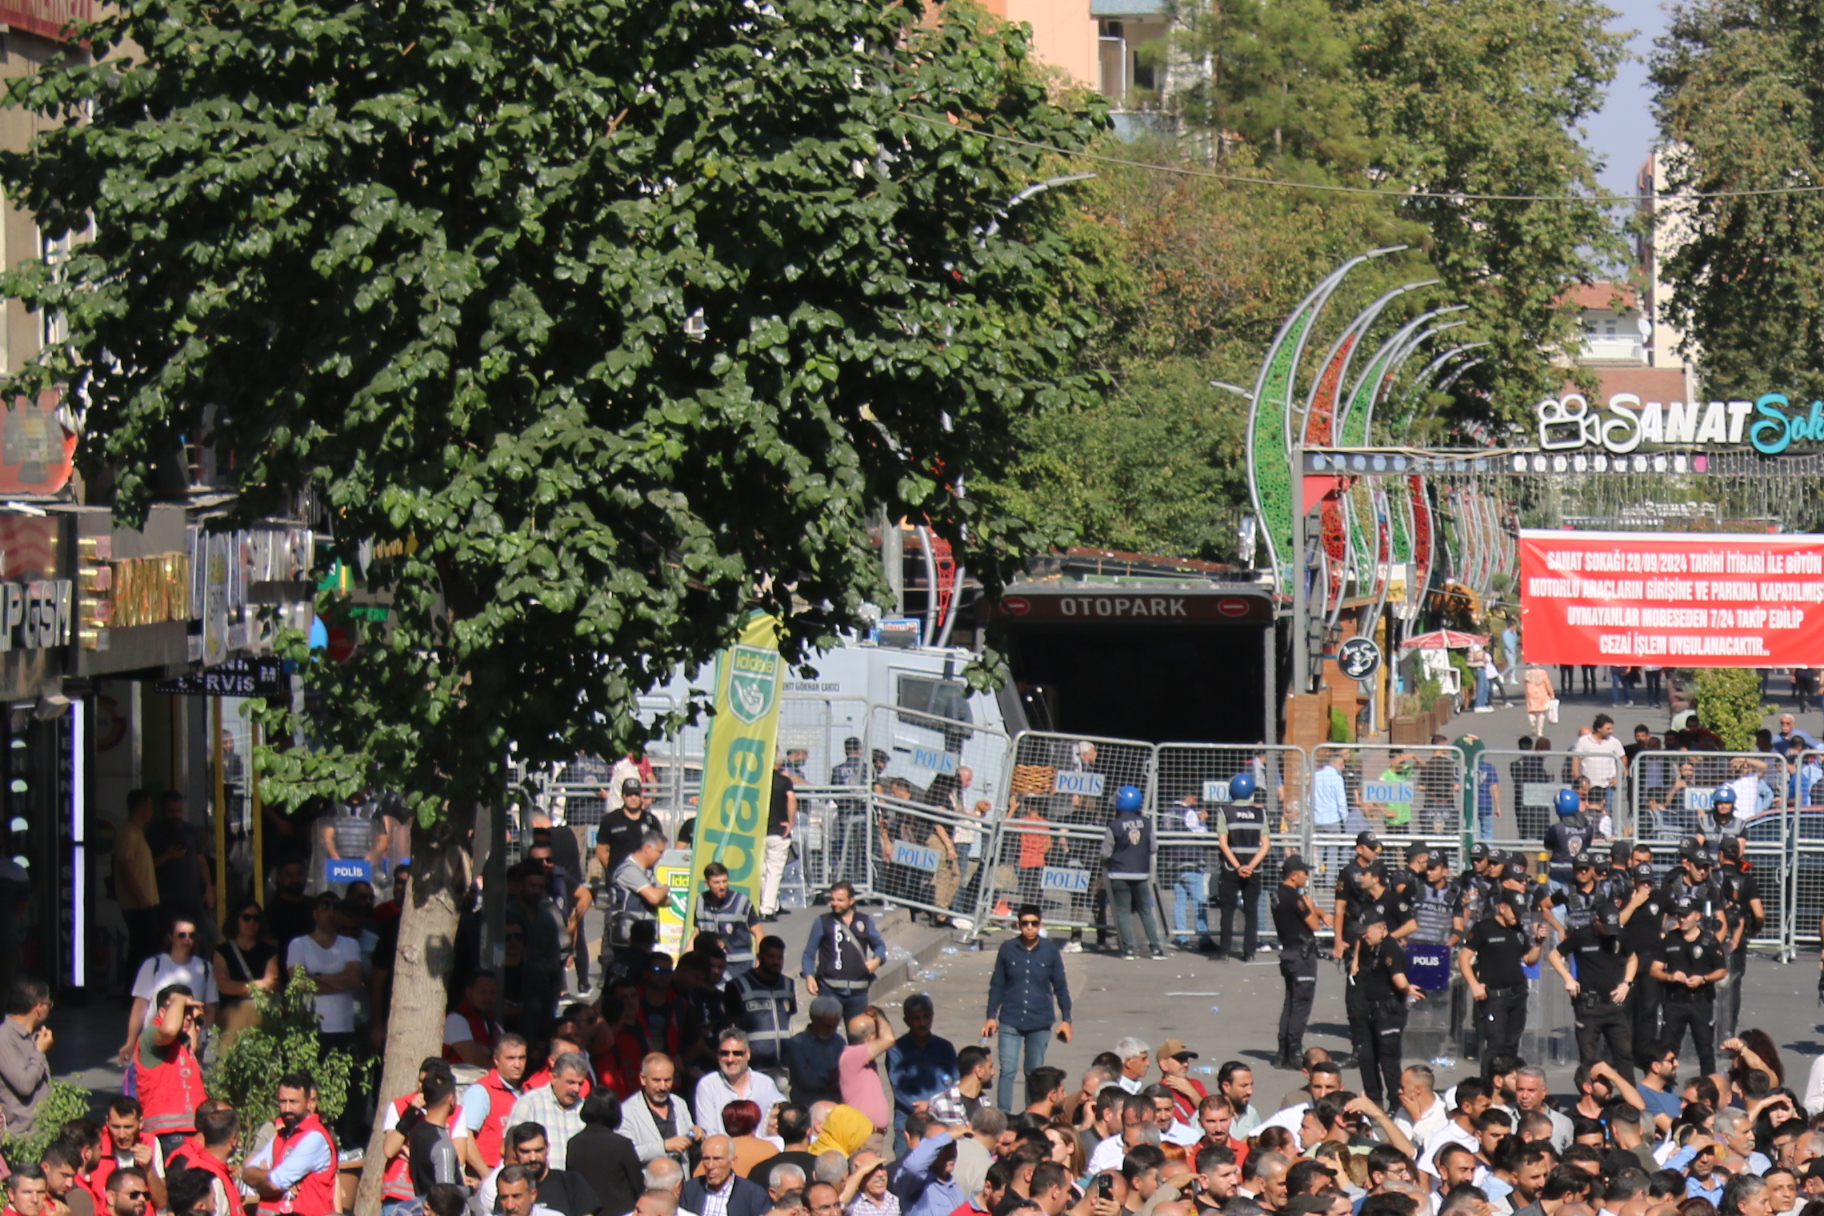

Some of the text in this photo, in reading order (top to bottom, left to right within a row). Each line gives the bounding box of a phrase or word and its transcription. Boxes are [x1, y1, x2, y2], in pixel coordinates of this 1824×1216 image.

[1602, 393, 1753, 454] SANAT
[1547, 551, 1583, 572] SANAT
[1585, 549, 1625, 572] SOKAĞI
[1626, 552, 1687, 574] 20/09/2024
[1766, 551, 1784, 575] İLE
[1785, 552, 1822, 575] BÜTÜN
[1529, 578, 1580, 599] MOTORLU
[1583, 579, 1643, 602] ARAÇLARIN
[1645, 577, 1693, 602] GİRİŞİNE
[1695, 582, 1709, 601] VE
[1711, 581, 1758, 601] PARKINA
[1061, 598, 1187, 616] OTOPARK
[1567, 606, 1804, 629] UYMAYANLAR MOBESEDEN 7/24 TAKİP EDİLİP
[1600, 632, 1632, 655] CEZAİ
[1634, 632, 1667, 657] İŞLEM
[735, 651, 775, 673] iddaa
[914, 748, 953, 772] POLİS
[1058, 773, 1101, 793] POLİS
[1365, 782, 1412, 801] POLİS
[895, 844, 935, 867] POLİS
[334, 866, 363, 877] POLİS
[1044, 870, 1089, 891] POLİS
